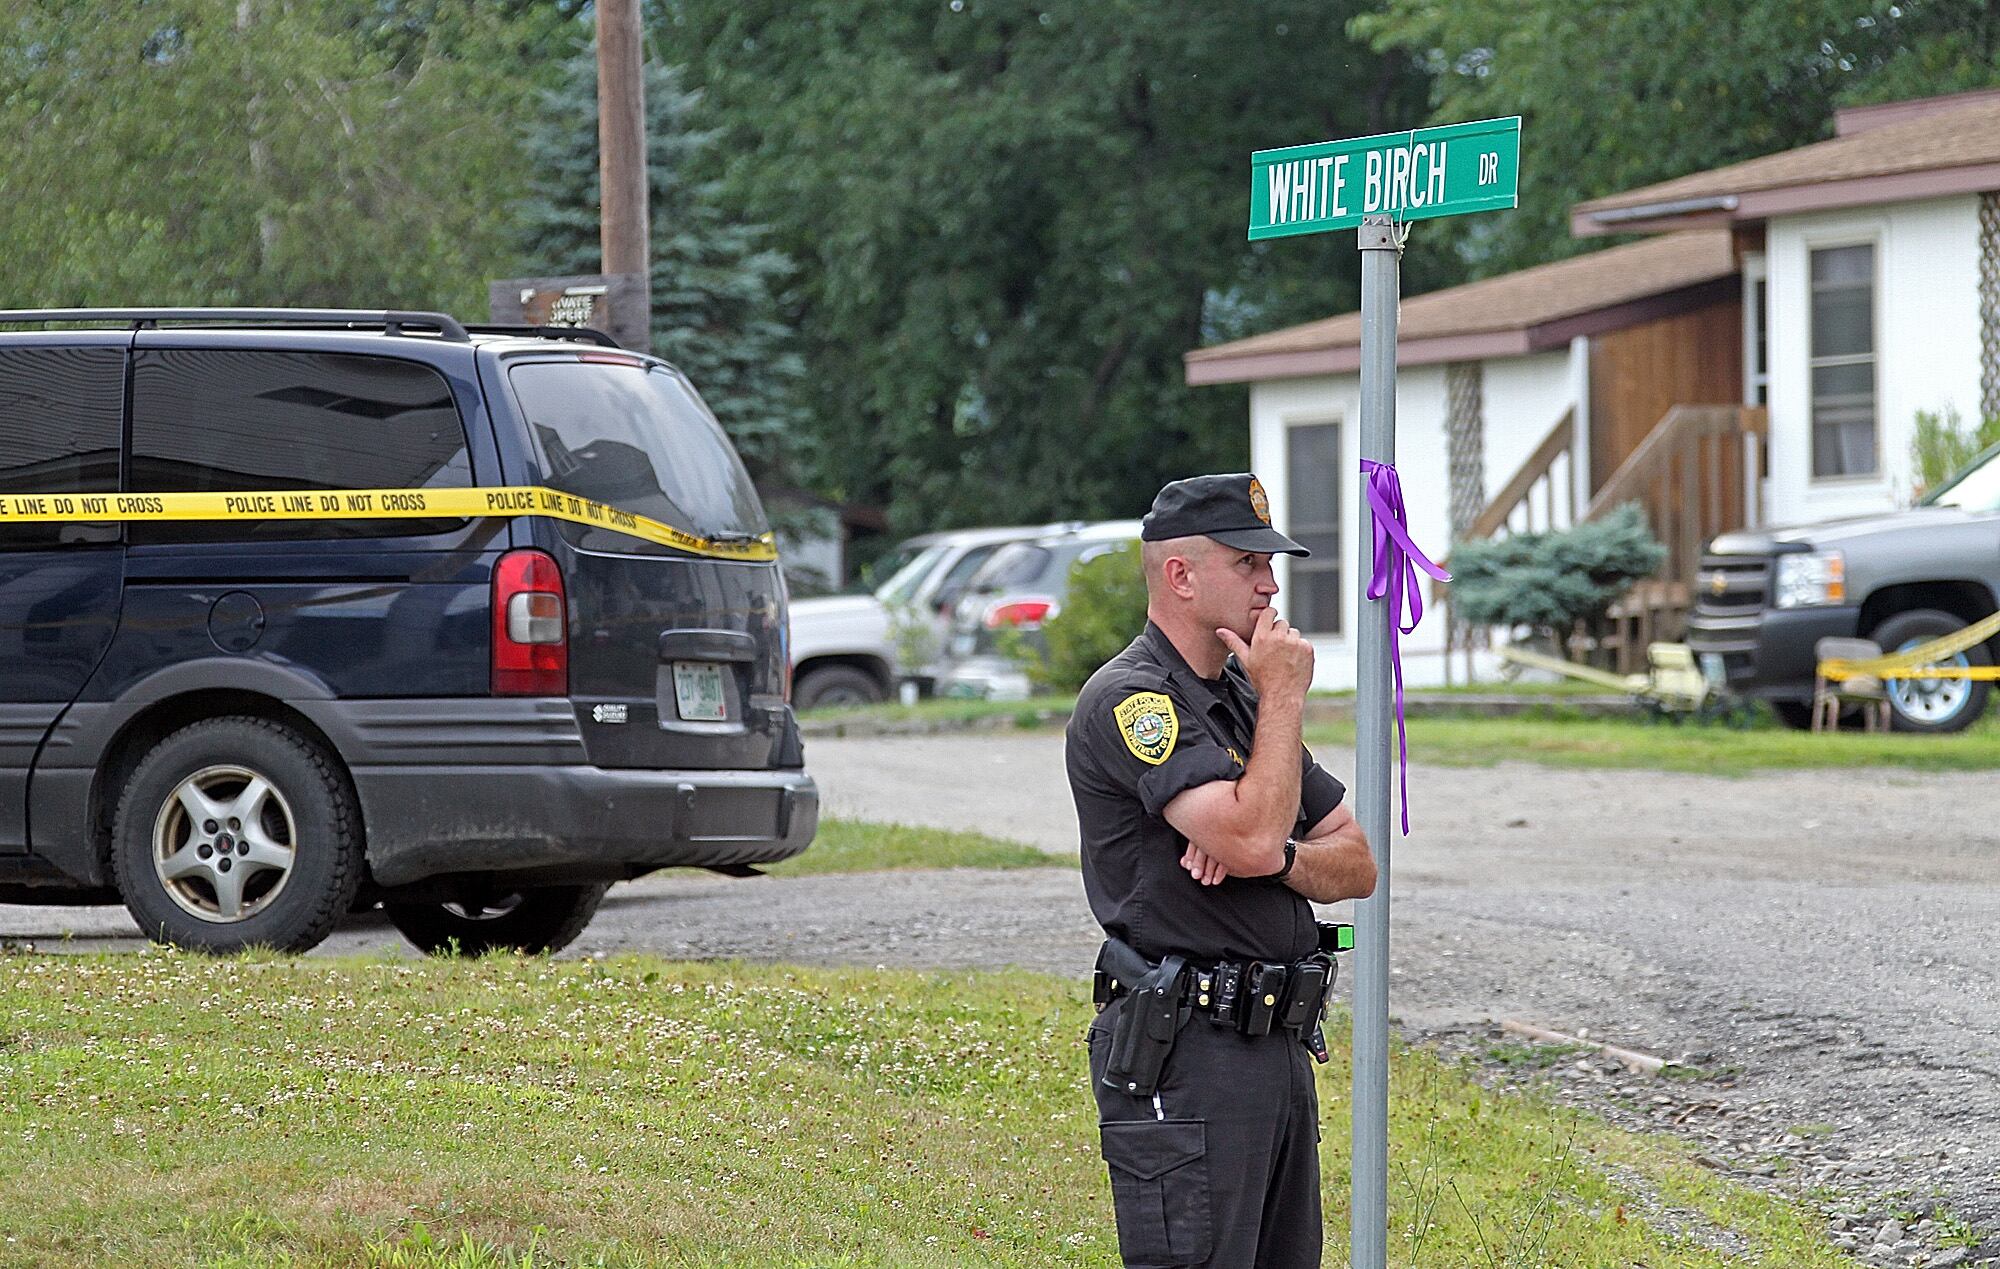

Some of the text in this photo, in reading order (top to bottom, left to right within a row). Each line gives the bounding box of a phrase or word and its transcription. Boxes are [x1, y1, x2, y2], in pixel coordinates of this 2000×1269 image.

[1268, 141, 1498, 225] WHITE BIRCH DR
[14, 498, 48, 515] LINE
[54, 498, 74, 514] DO
[81, 497, 108, 514] NOT
[117, 496, 163, 513] CROSS
[225, 494, 426, 513] POLICE LINE DO NOT CROSS
[486, 491, 637, 529] POLICE LINE DO NOT CROSS
